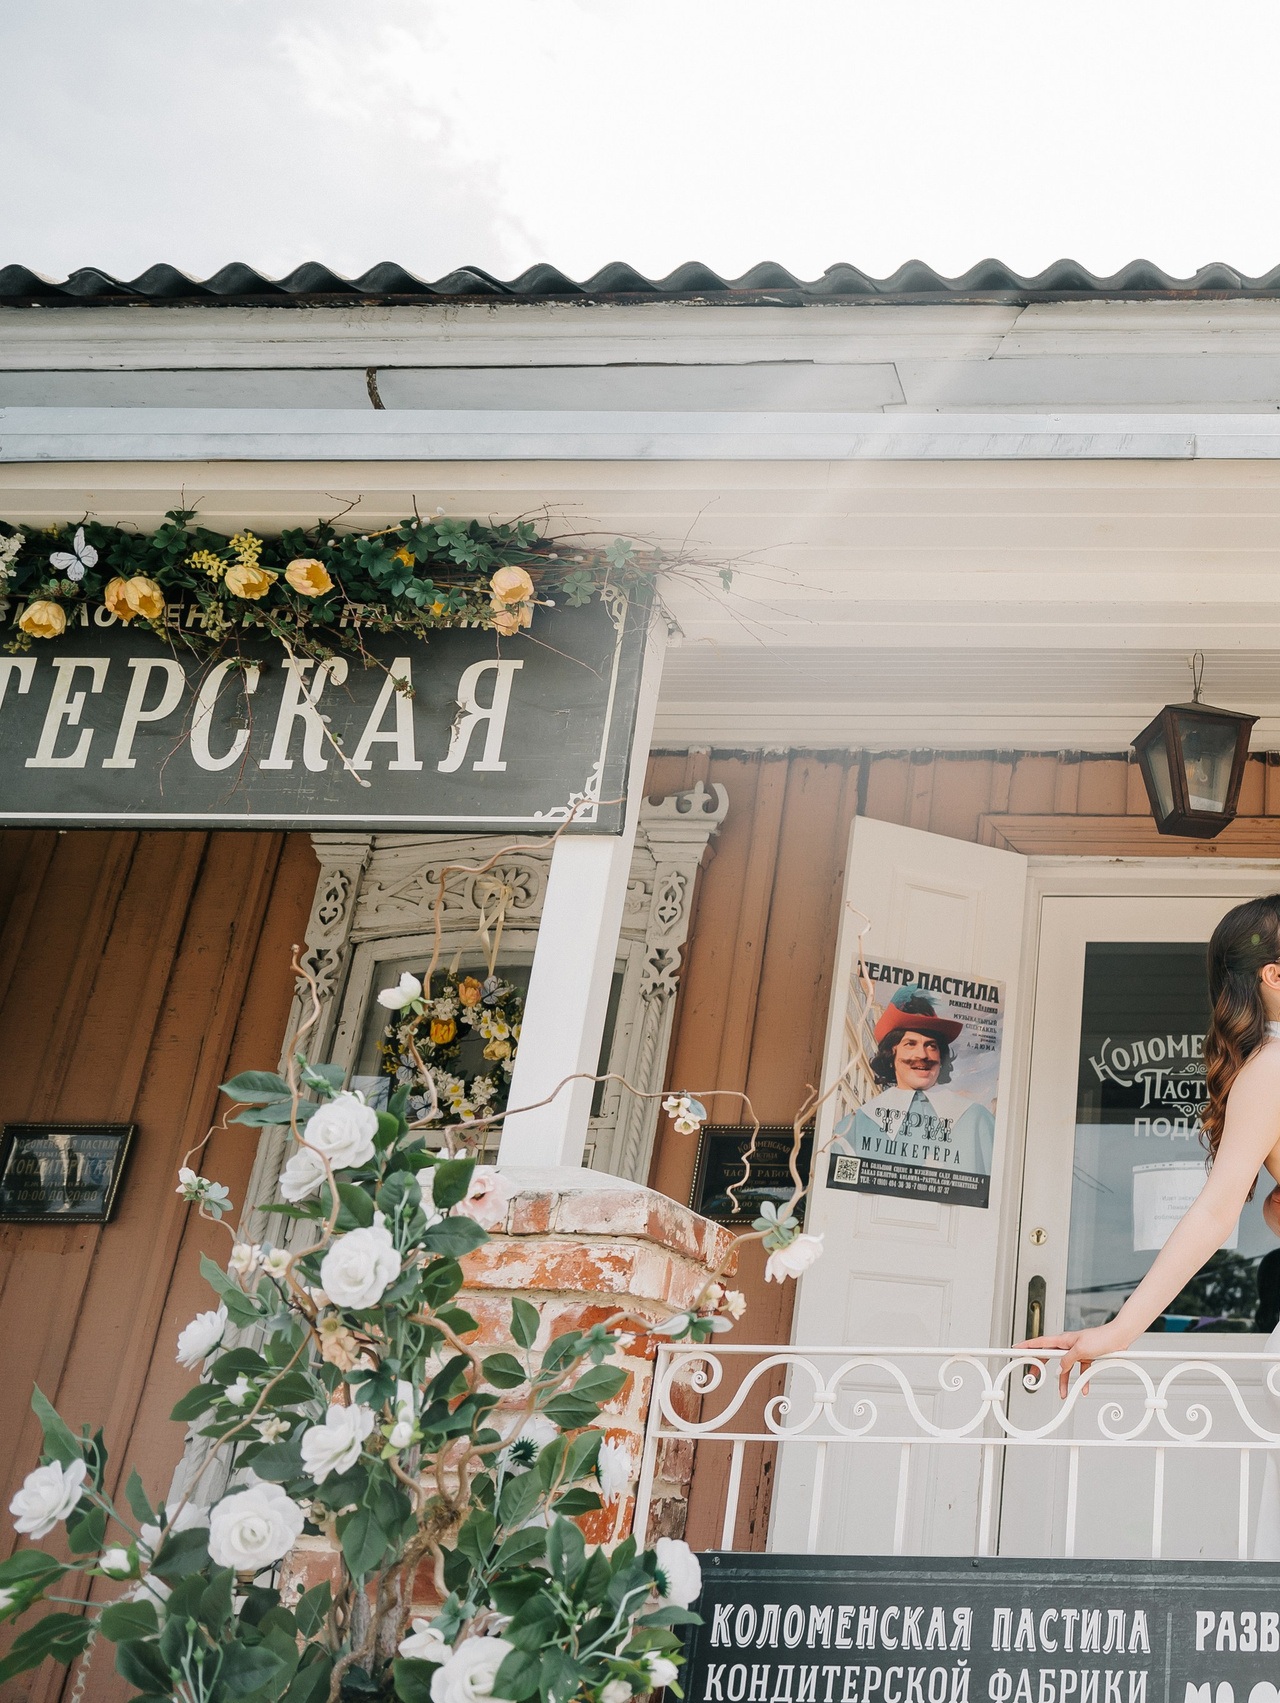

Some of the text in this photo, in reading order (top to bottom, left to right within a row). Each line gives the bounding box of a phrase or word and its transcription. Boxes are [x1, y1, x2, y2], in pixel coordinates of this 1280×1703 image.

[0, 657, 524, 773] ТЕРСКАЯ
[857, 960, 1000, 1003] ТЕАТР ПАСТИЛА
[1088, 1034, 1205, 1087] КОЛОМЕ
[1135, 1067, 1210, 1109] ПАСТ
[875, 1107, 954, 1143] ТРИ
[1134, 1117, 1206, 1140] ПОДА
[861, 1136, 961, 1164] МУШКЕТЁРА
[757, 1169, 792, 1177] РАБОТ
[710, 1603, 1150, 1654] КОЛОМЕНСКАЯ ПАСТИЛА
[703, 1659, 971, 1703] КОНДИТЕРСКОЙ
[988, 1668, 1149, 1703] ФАБРИКИ
